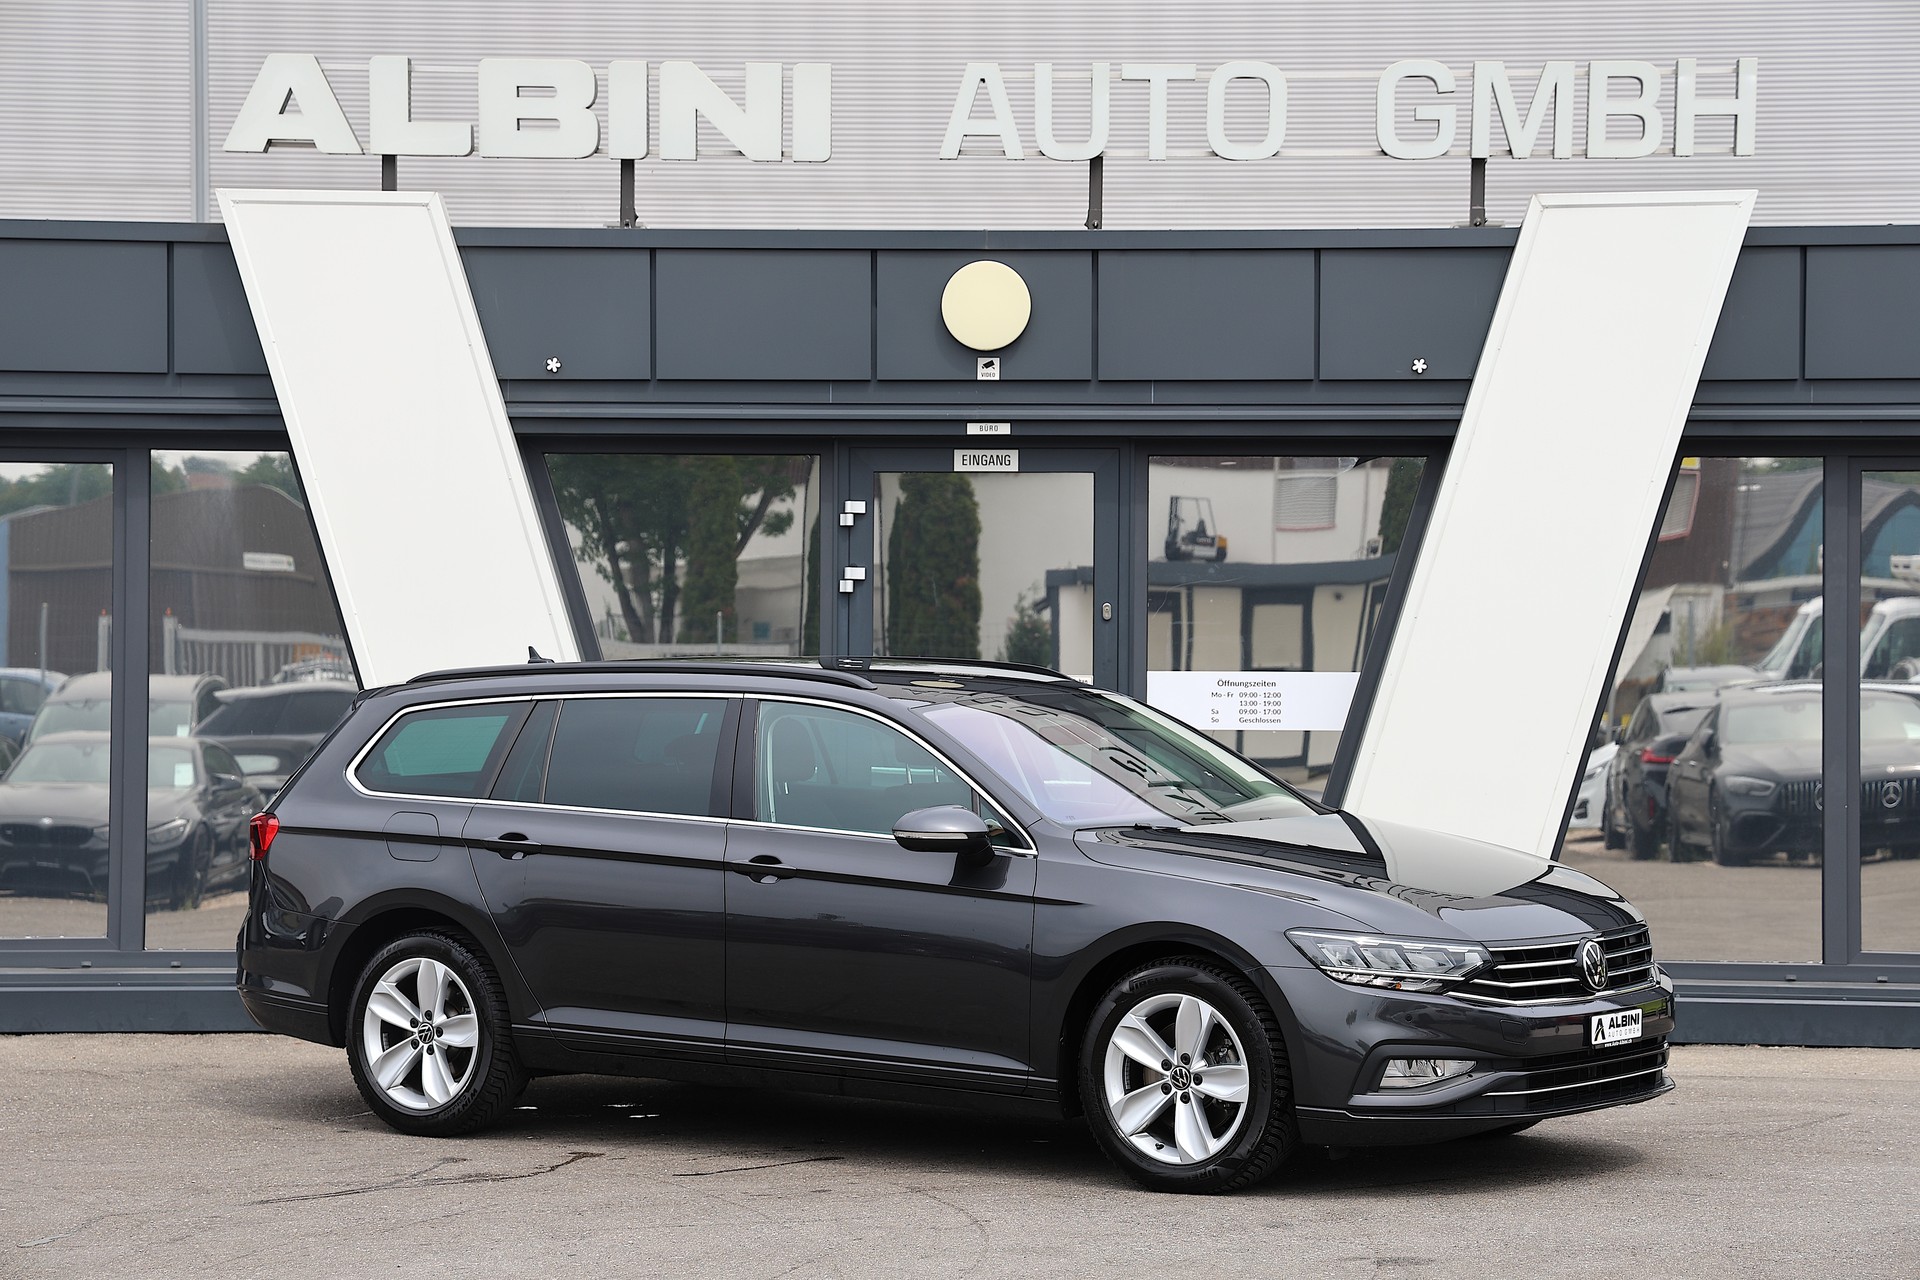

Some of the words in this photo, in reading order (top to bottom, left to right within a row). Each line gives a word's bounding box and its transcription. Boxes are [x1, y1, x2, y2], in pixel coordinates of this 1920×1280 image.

[223, 52, 833, 163] ALBINI
[938, 60, 1288, 162] AUTO
[1375, 57, 1758, 161] GMBH
[979, 424, 999, 432] BÜRO
[961, 454, 1011, 466] EINGANG
[1217, 679, 1276, 688] Öffnungszeiten
[1239, 716, 1282, 724] Geschlossen
[1608, 1012, 1640, 1030] ALBINI
